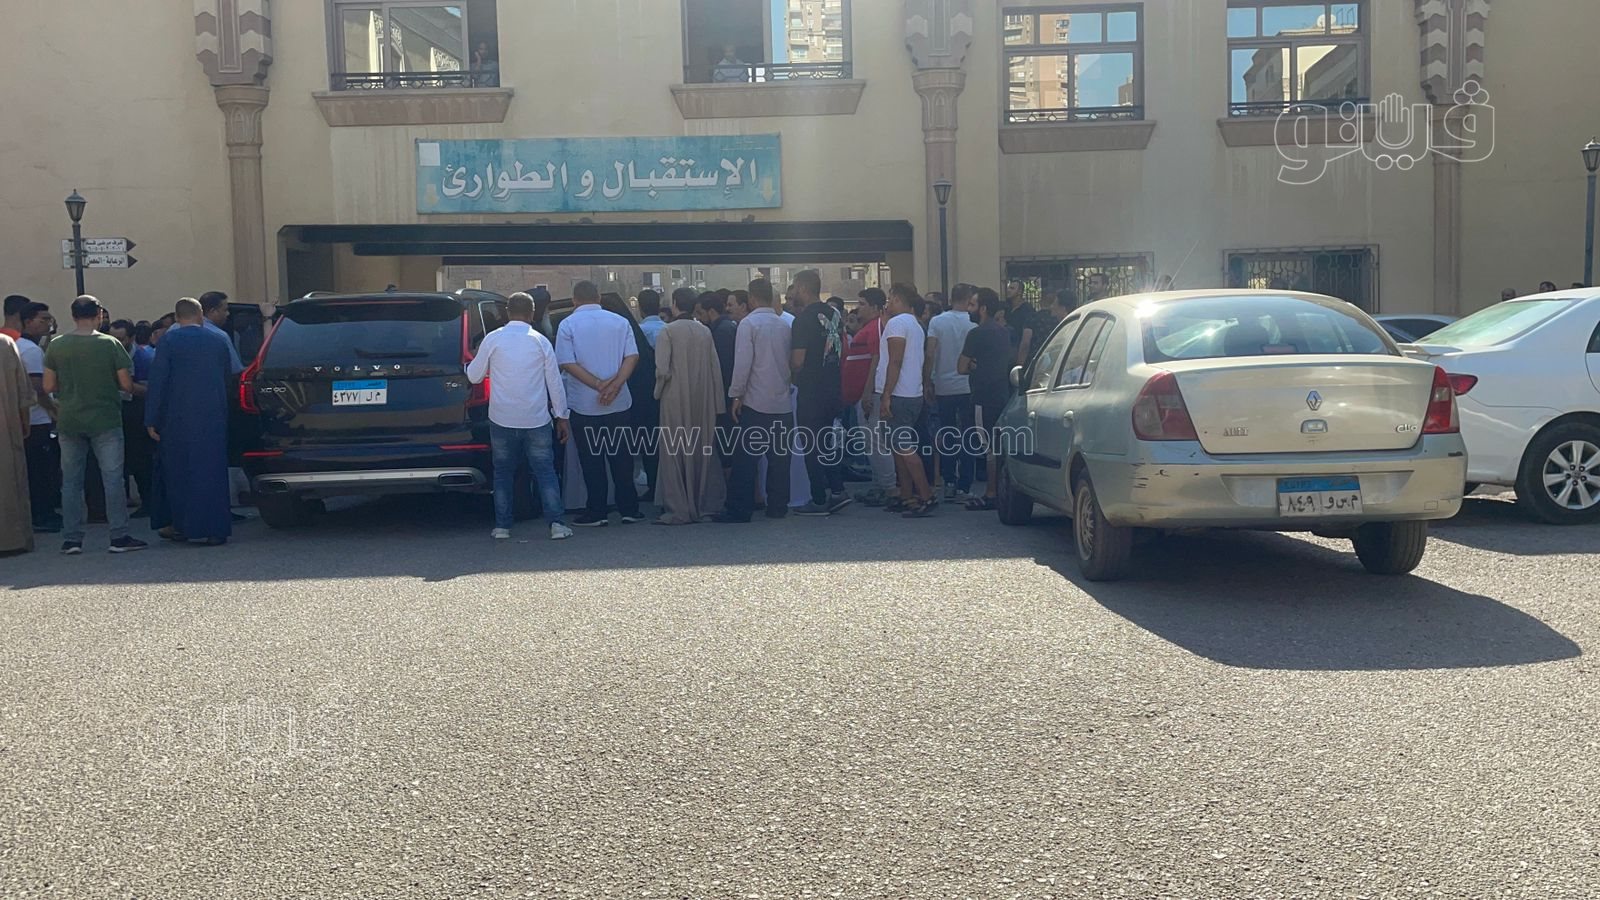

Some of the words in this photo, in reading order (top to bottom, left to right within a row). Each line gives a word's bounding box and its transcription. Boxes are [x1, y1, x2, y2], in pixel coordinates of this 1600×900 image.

[441, 160, 569, 199] الطوارئ
[574, 165, 594, 199] و
[602, 155, 758, 199] الإستقبال
[314, 363, 401, 372] VOLVO
